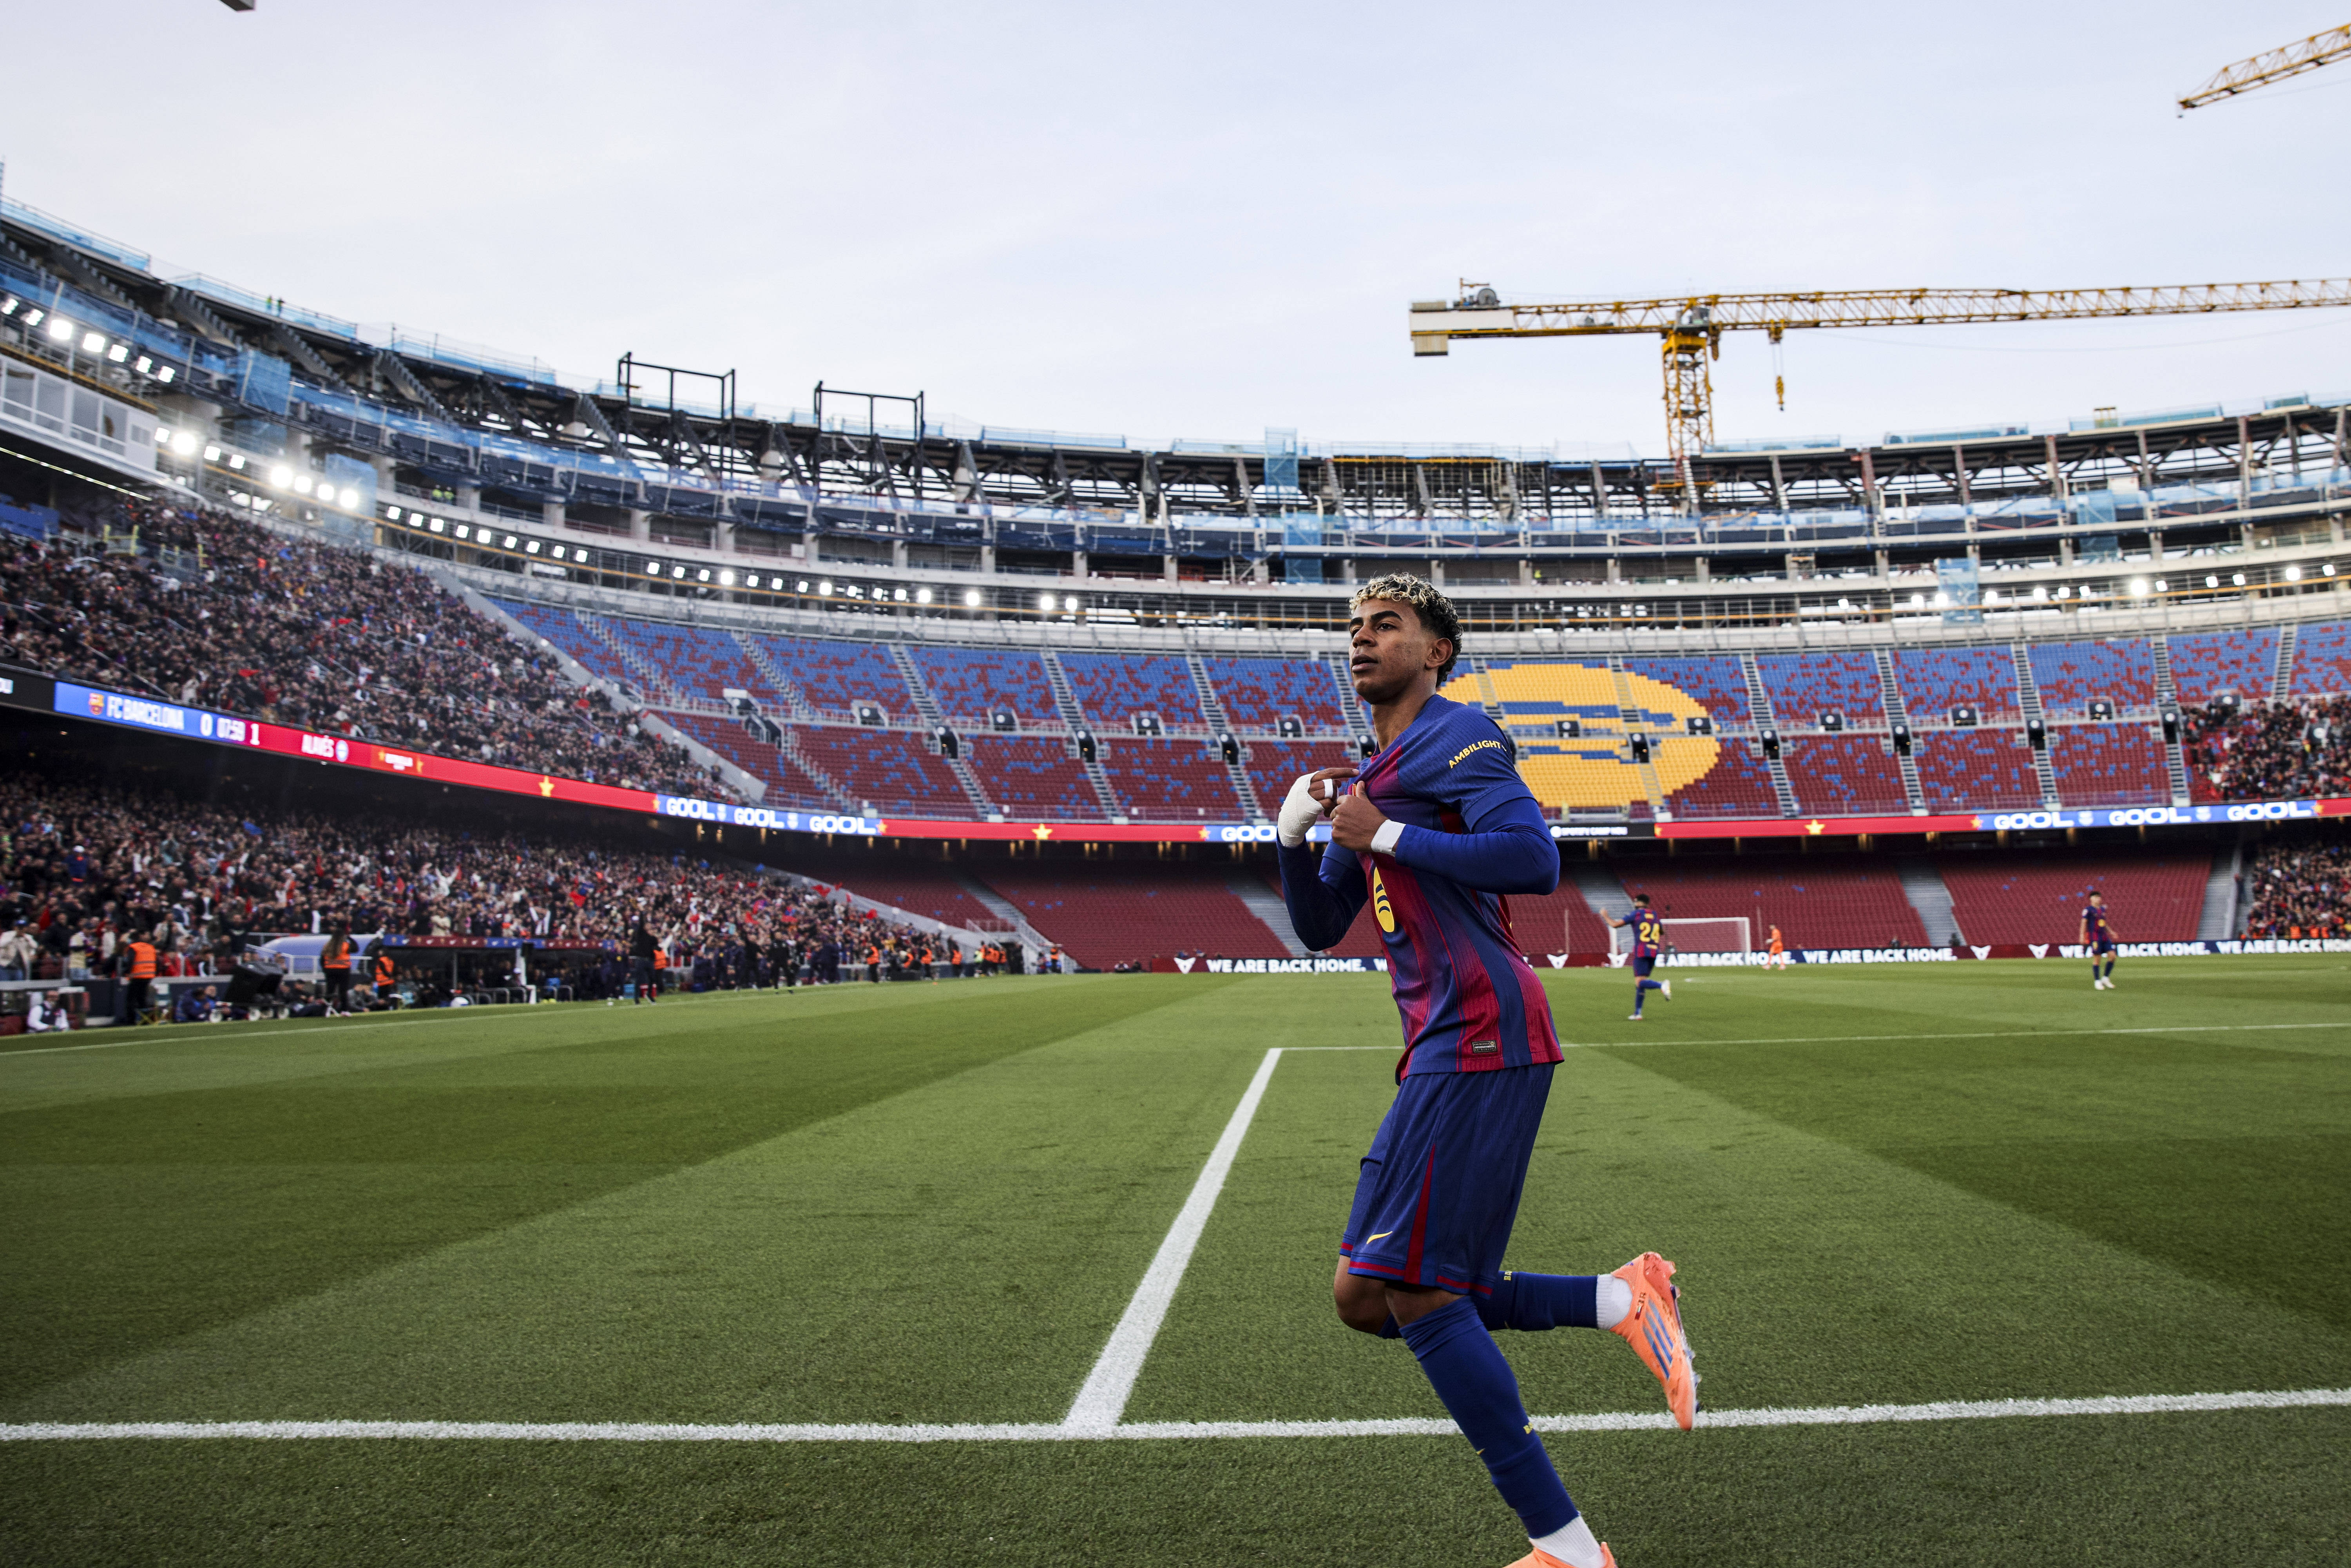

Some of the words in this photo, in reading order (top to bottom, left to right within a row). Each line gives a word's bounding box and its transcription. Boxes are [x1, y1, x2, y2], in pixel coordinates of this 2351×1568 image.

[107, 695, 123, 719] FC
[122, 698, 184, 730] BARCELONA
[200, 713, 213, 736] 0
[250, 723, 260, 745] 1
[1449, 740, 1501, 769] AMBILIGHT
[666, 797, 716, 820] GOOL
[734, 807, 785, 828] GOOL
[809, 815, 876, 835] GOOL
[1993, 811, 2075, 830] GOOL
[2108, 806, 2192, 826] GOOL
[2226, 801, 2312, 822] GOOL
[1221, 825, 1277, 842] GOO
[1639, 922, 1660, 943] 24
[2058, 945, 2085, 958] WE
[2116, 943, 2160, 957] BACK
[2159, 942, 2211, 956] HOME.
[2215, 941, 2242, 954] WE
[2243, 940, 2276, 954] ARE
[2276, 939, 2323, 953] BACK
[1654, 953, 1665, 967] E
[1666, 952, 1699, 967] ARE
[1699, 952, 1744, 967] BACK
[1802, 950, 1829, 964] WE
[1829, 950, 1862, 963] ARE
[1862, 949, 1906, 963] BACK
[1906, 948, 1958, 962] HOME.
[1206, 959, 1233, 973] WE
[1233, 959, 1267, 973] ARE
[1268, 959, 1313, 974] BACK
[1314, 958, 1367, 972] HOME.
